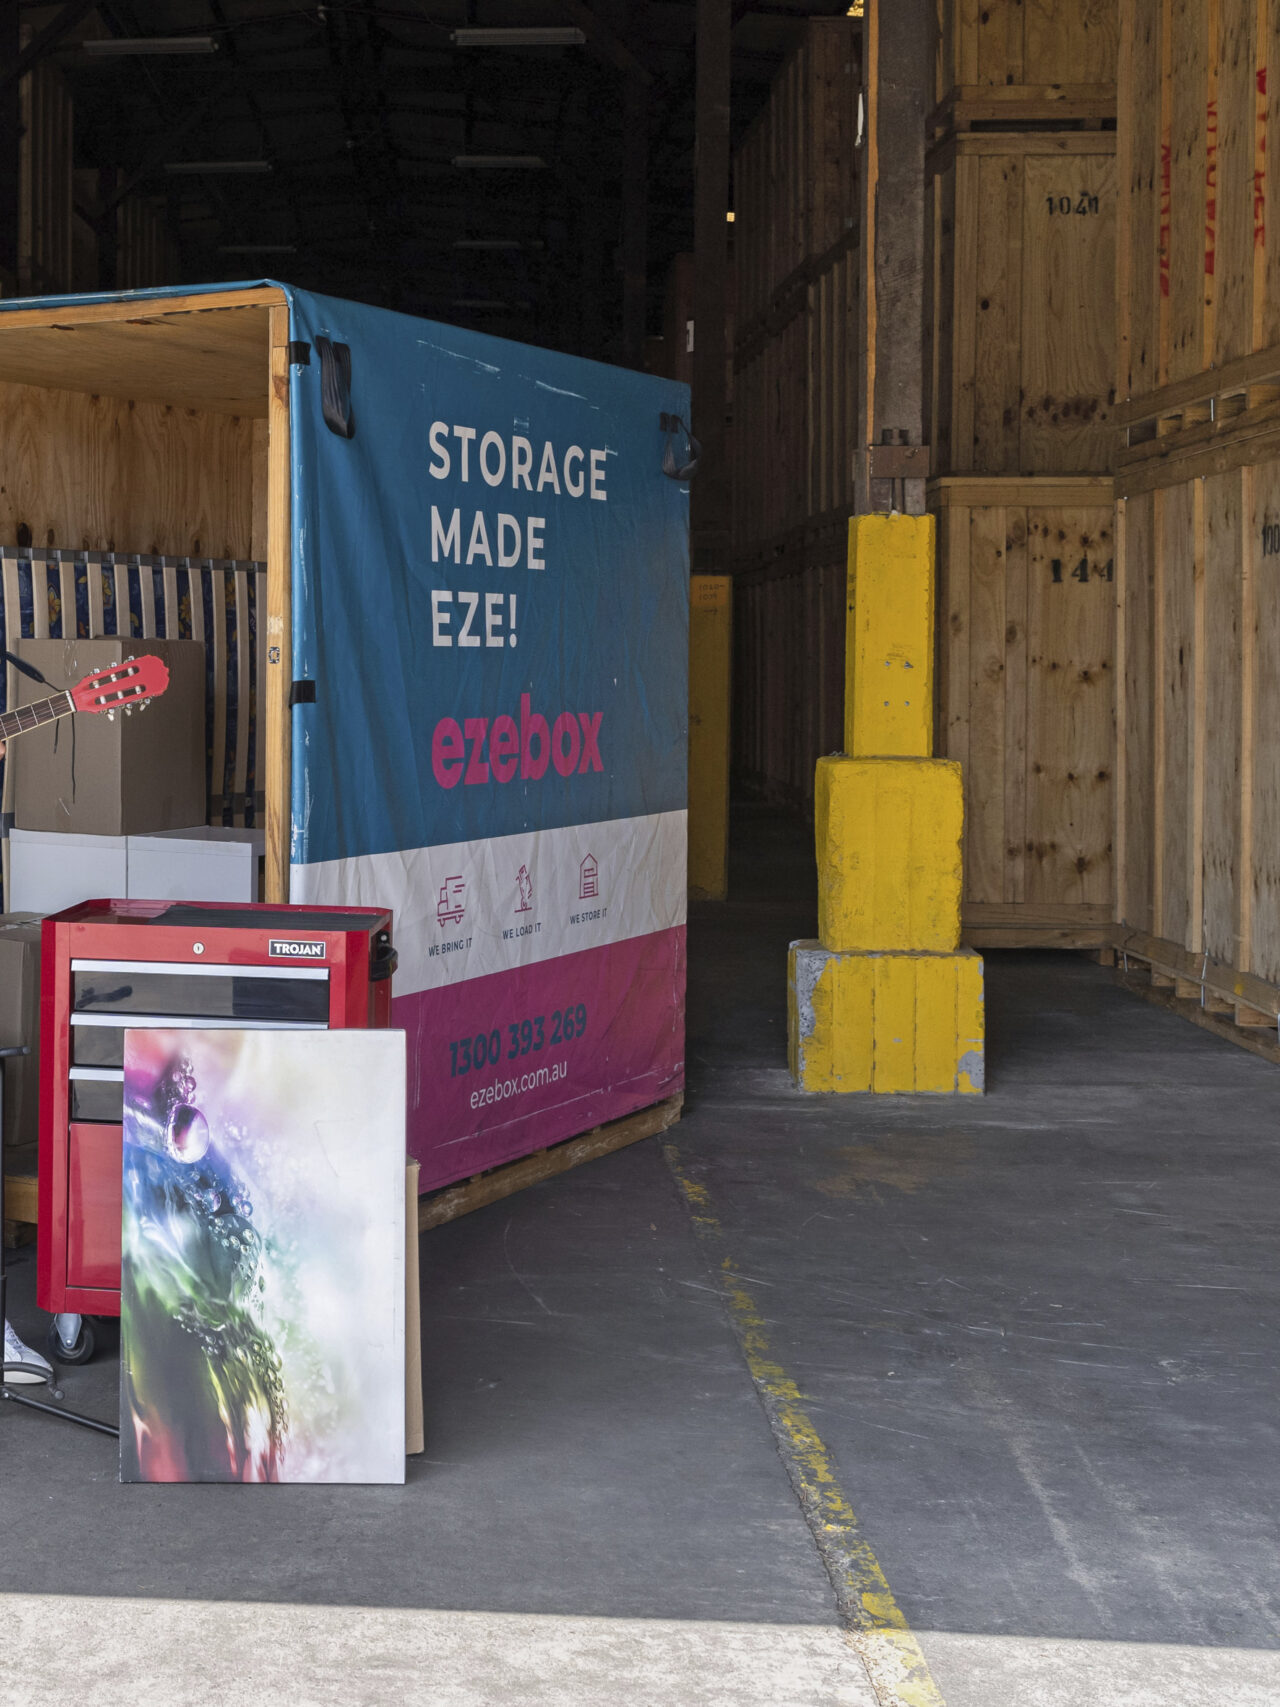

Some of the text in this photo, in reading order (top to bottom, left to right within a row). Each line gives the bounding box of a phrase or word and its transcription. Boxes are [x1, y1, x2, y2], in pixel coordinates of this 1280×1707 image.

[428, 420, 608, 501] STORAGE
[430, 504, 546, 571] MADE
[430, 589, 518, 648] EZE!
[430, 692, 605, 790] ezebox
[502, 922, 542, 940] WE LOAD IT
[569, 908, 608, 925] WE STORE IT
[273, 943, 322, 956] TROJAN
[428, 937, 473, 957] WE BRING IT
[448, 1002, 587, 1078] 1300 393 269
[470, 1060, 568, 1110] ezebox.com.au
